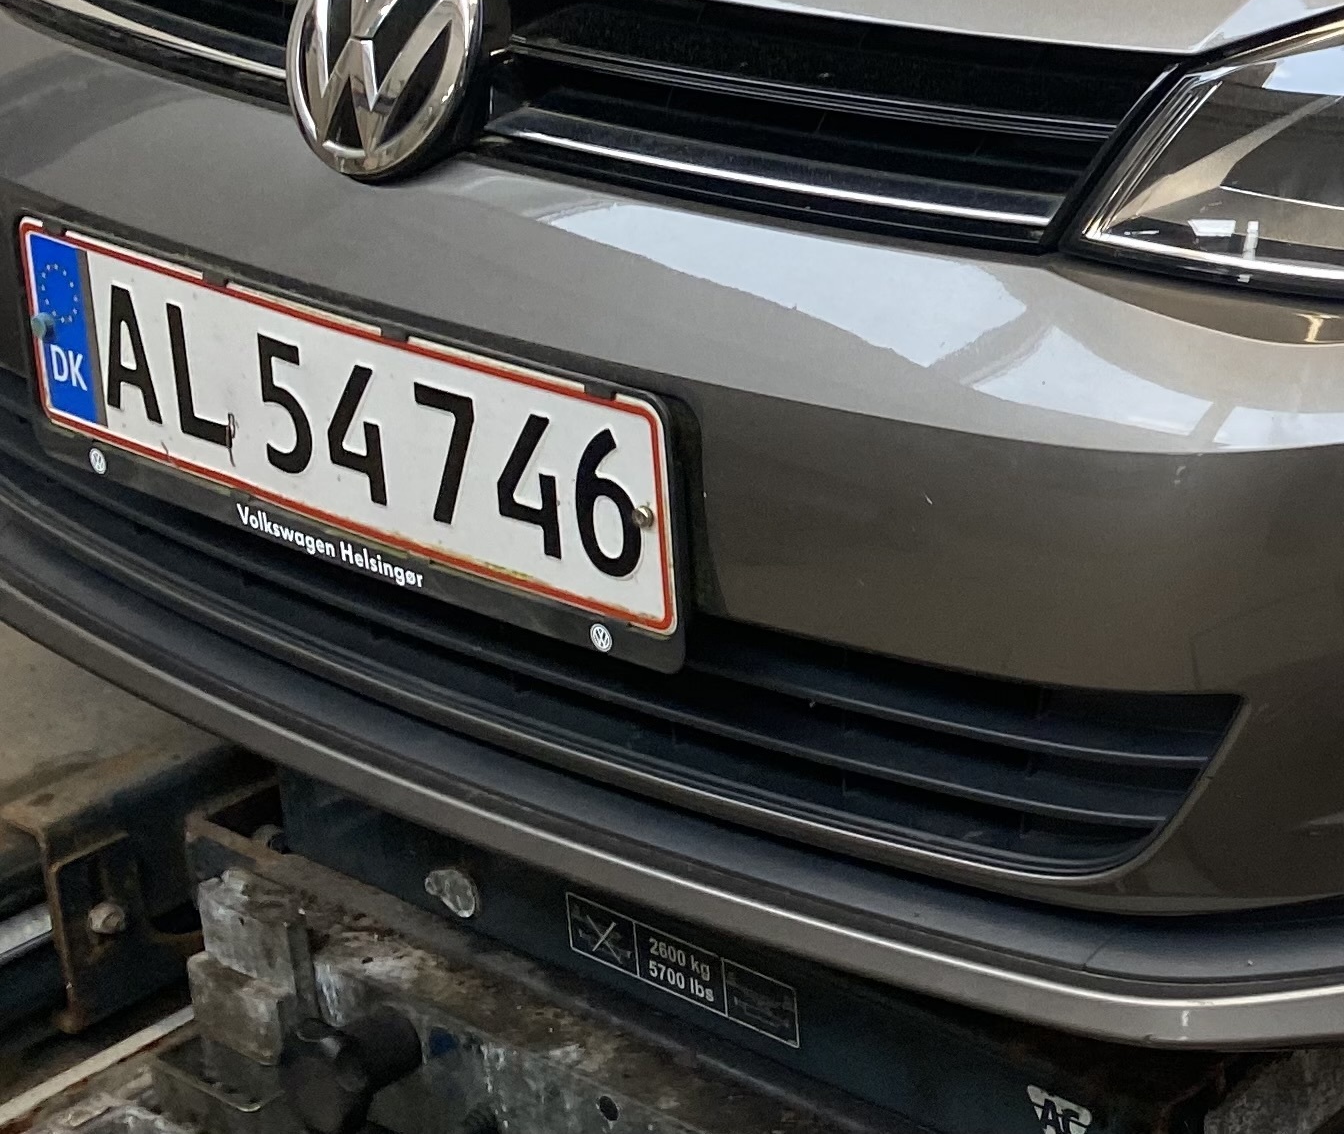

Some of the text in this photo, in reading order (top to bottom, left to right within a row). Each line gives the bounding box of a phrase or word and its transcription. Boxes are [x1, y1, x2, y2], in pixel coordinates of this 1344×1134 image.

[50, 343, 88, 392] DK
[106, 284, 233, 449] AL
[236, 503, 424, 587] Volkswagen Helsingør
[649, 937, 711, 982] 2600 kg
[649, 959, 714, 1002] 5700 lbs
